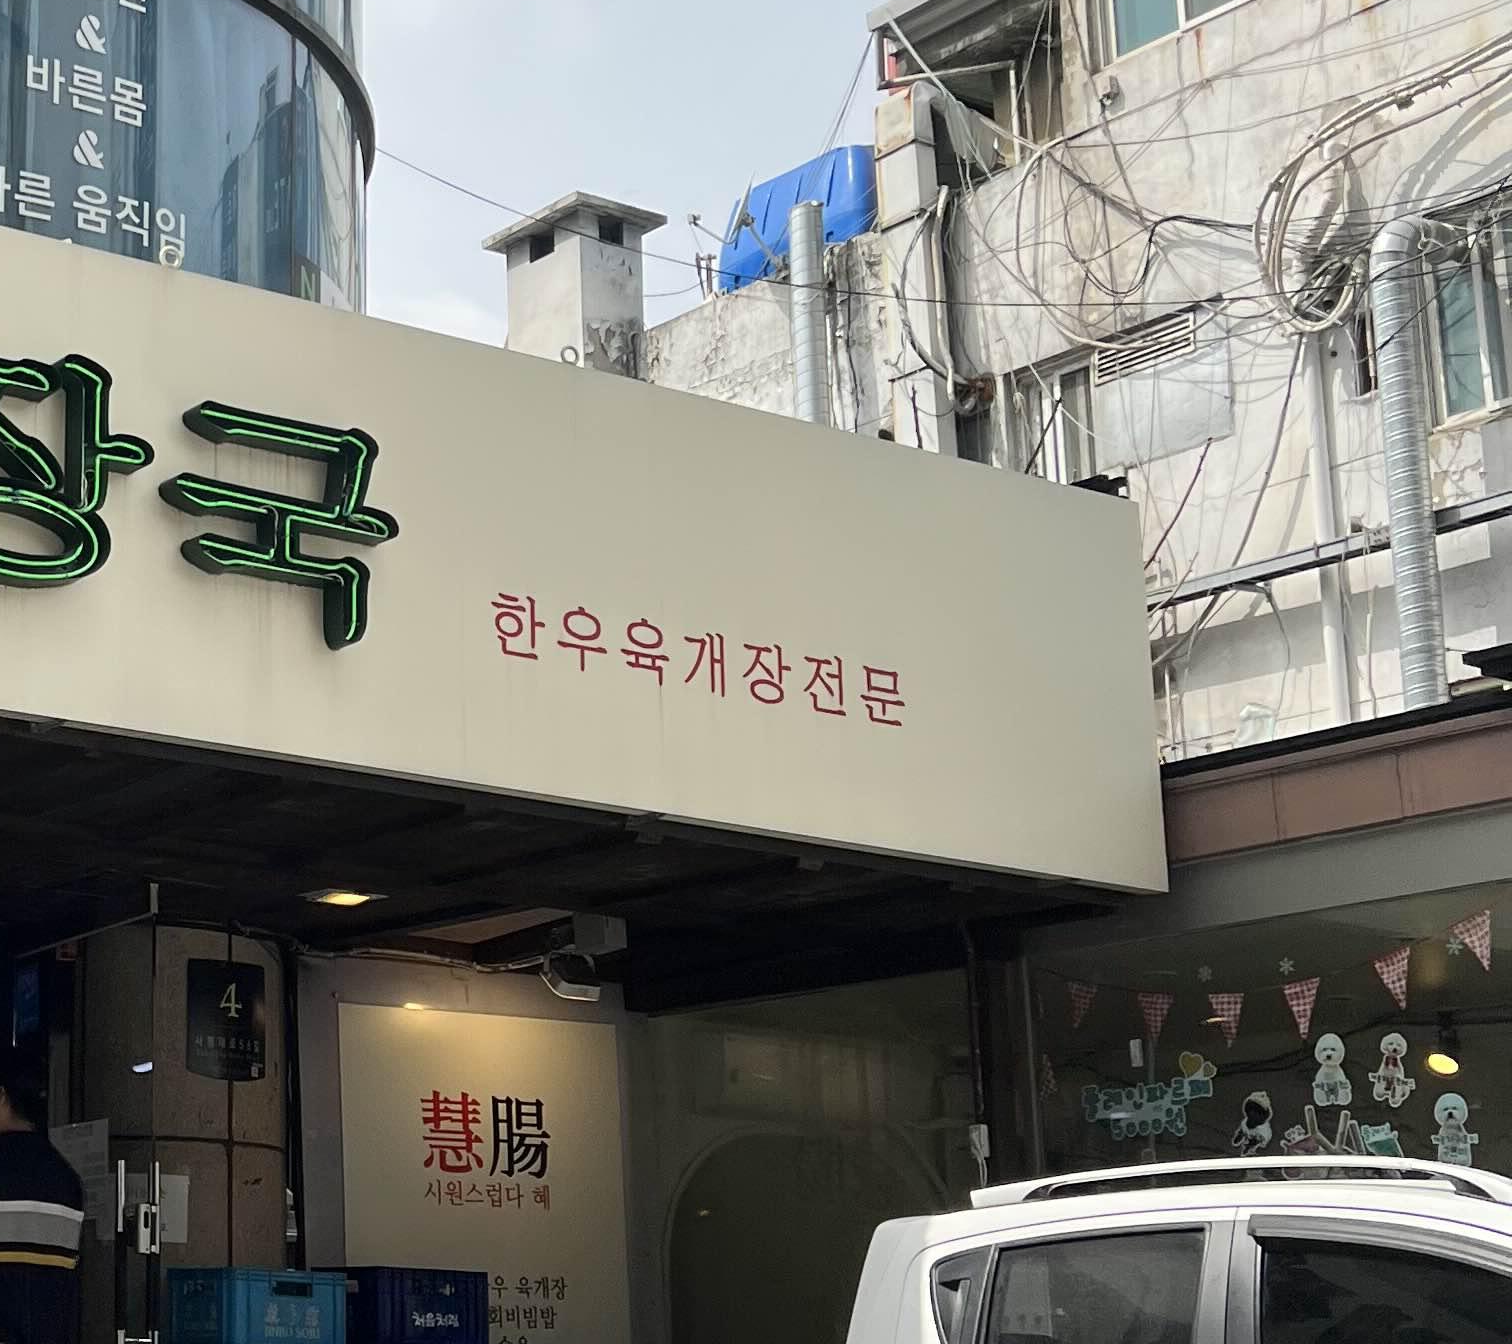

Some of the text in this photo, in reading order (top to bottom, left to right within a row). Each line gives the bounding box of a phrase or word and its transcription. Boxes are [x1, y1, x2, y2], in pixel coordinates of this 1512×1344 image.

[76, 14, 106, 54] &
[25, 54, 147, 128] 바른몸
[73, 129, 105, 170] &
[491, 588, 907, 727] 한우육개장전문
[220, 982, 243, 1018] 4
[424, 1179, 551, 1210] 시원스럽다 혜
[515, 1276, 569, 1301] 육개장
